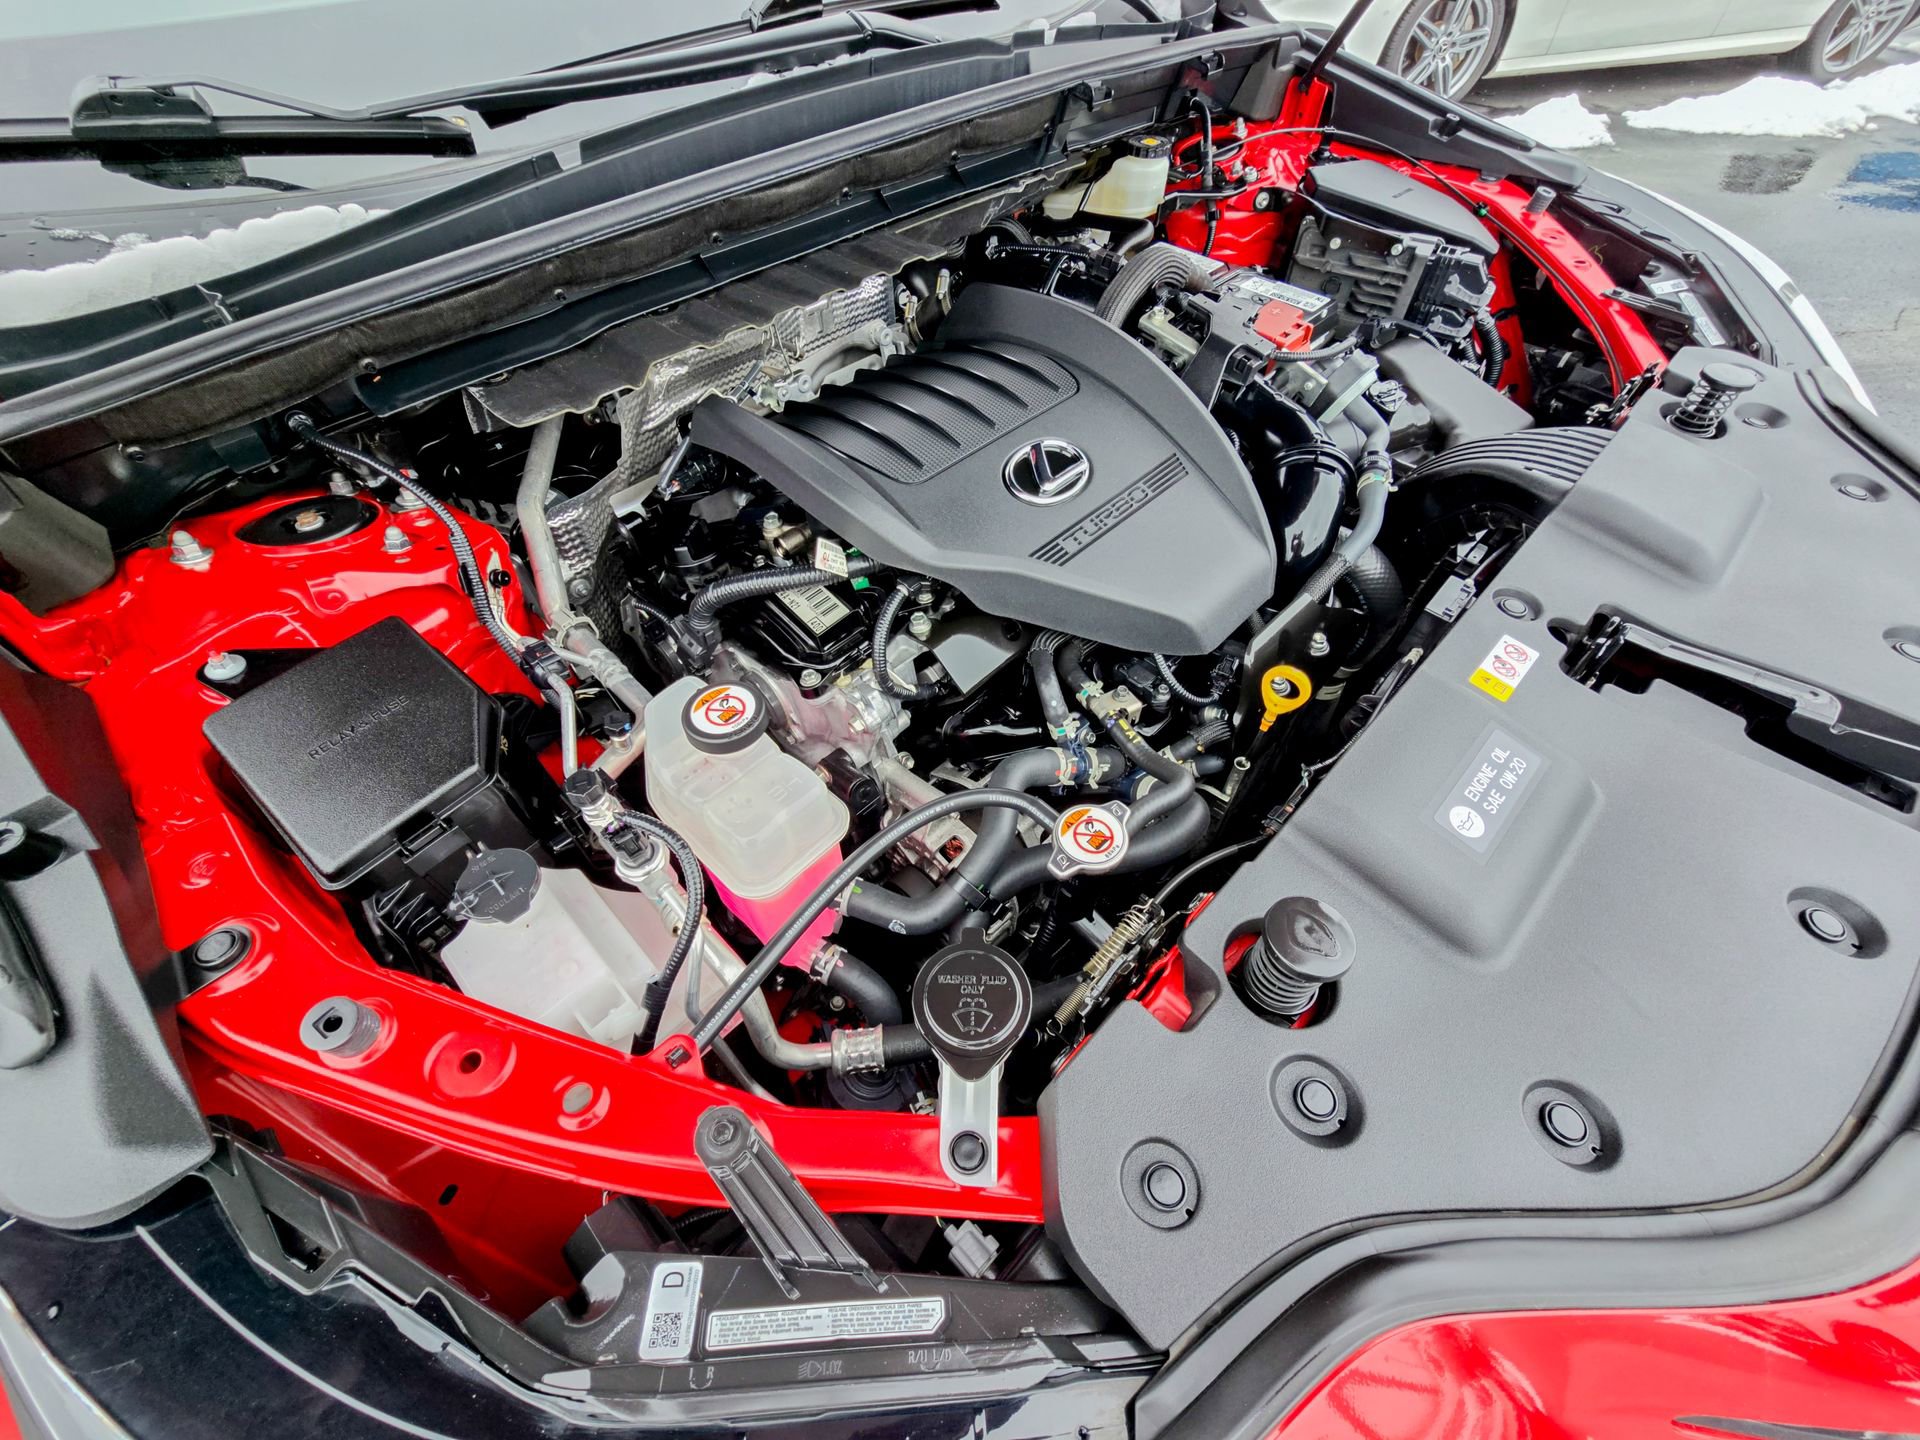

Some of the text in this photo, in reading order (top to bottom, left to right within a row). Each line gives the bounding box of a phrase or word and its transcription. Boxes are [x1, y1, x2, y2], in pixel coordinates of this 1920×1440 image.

[1061, 485, 1150, 551] TURBO
[307, 725, 355, 760] RELAY
[369, 695, 410, 722] FUSE
[1464, 747, 1511, 802] ENGINE OIL
[1483, 757, 1527, 814] SAE 0W-20
[937, 975, 1007, 985] WASHER FLUID
[960, 985, 985, 994] ONLY
[661, 1271, 684, 1289] D
[706, 1366, 714, 1379] R
